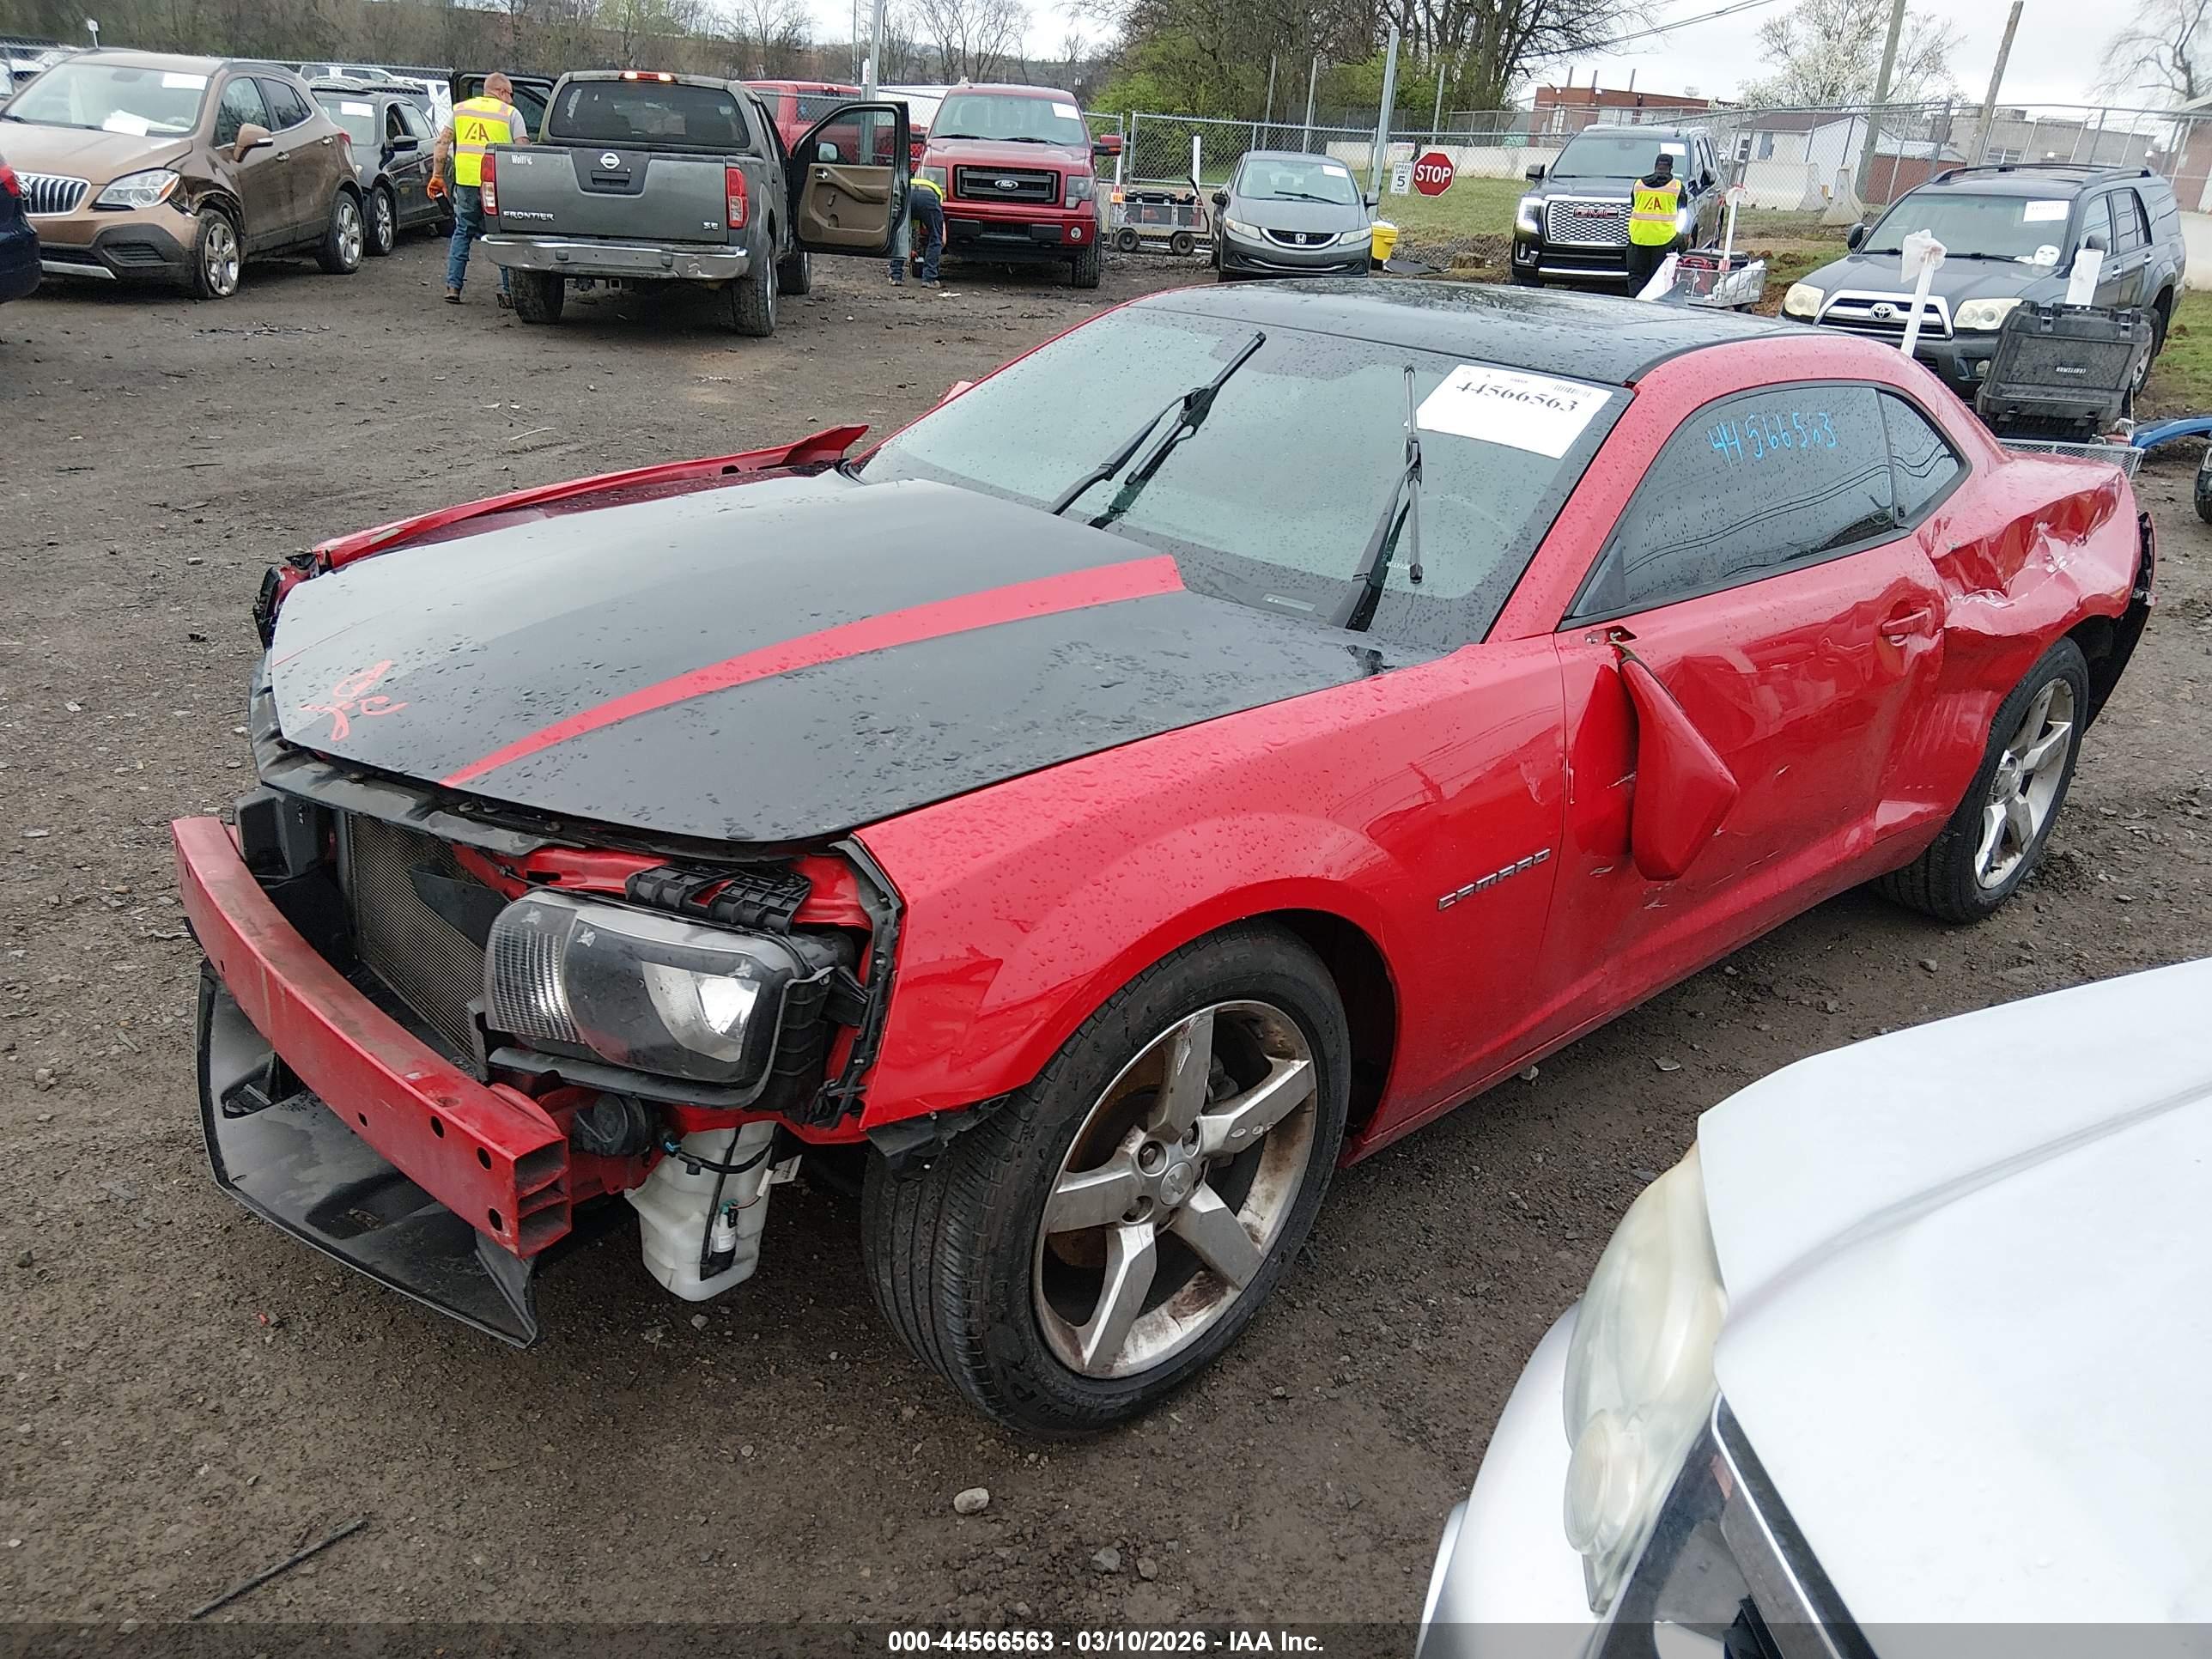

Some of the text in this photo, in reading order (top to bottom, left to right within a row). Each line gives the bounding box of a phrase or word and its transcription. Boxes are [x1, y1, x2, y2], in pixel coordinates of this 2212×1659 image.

[1415, 164, 1451, 184] STOP
[1397, 175, 1406, 187] 5
[503, 210, 554, 220] FRONTIER
[1575, 208, 1618, 219] GMC
[703, 222, 719, 230] SE
[1455, 381, 1578, 412] 44566563
[1437, 848, 1551, 910] CAMARO
